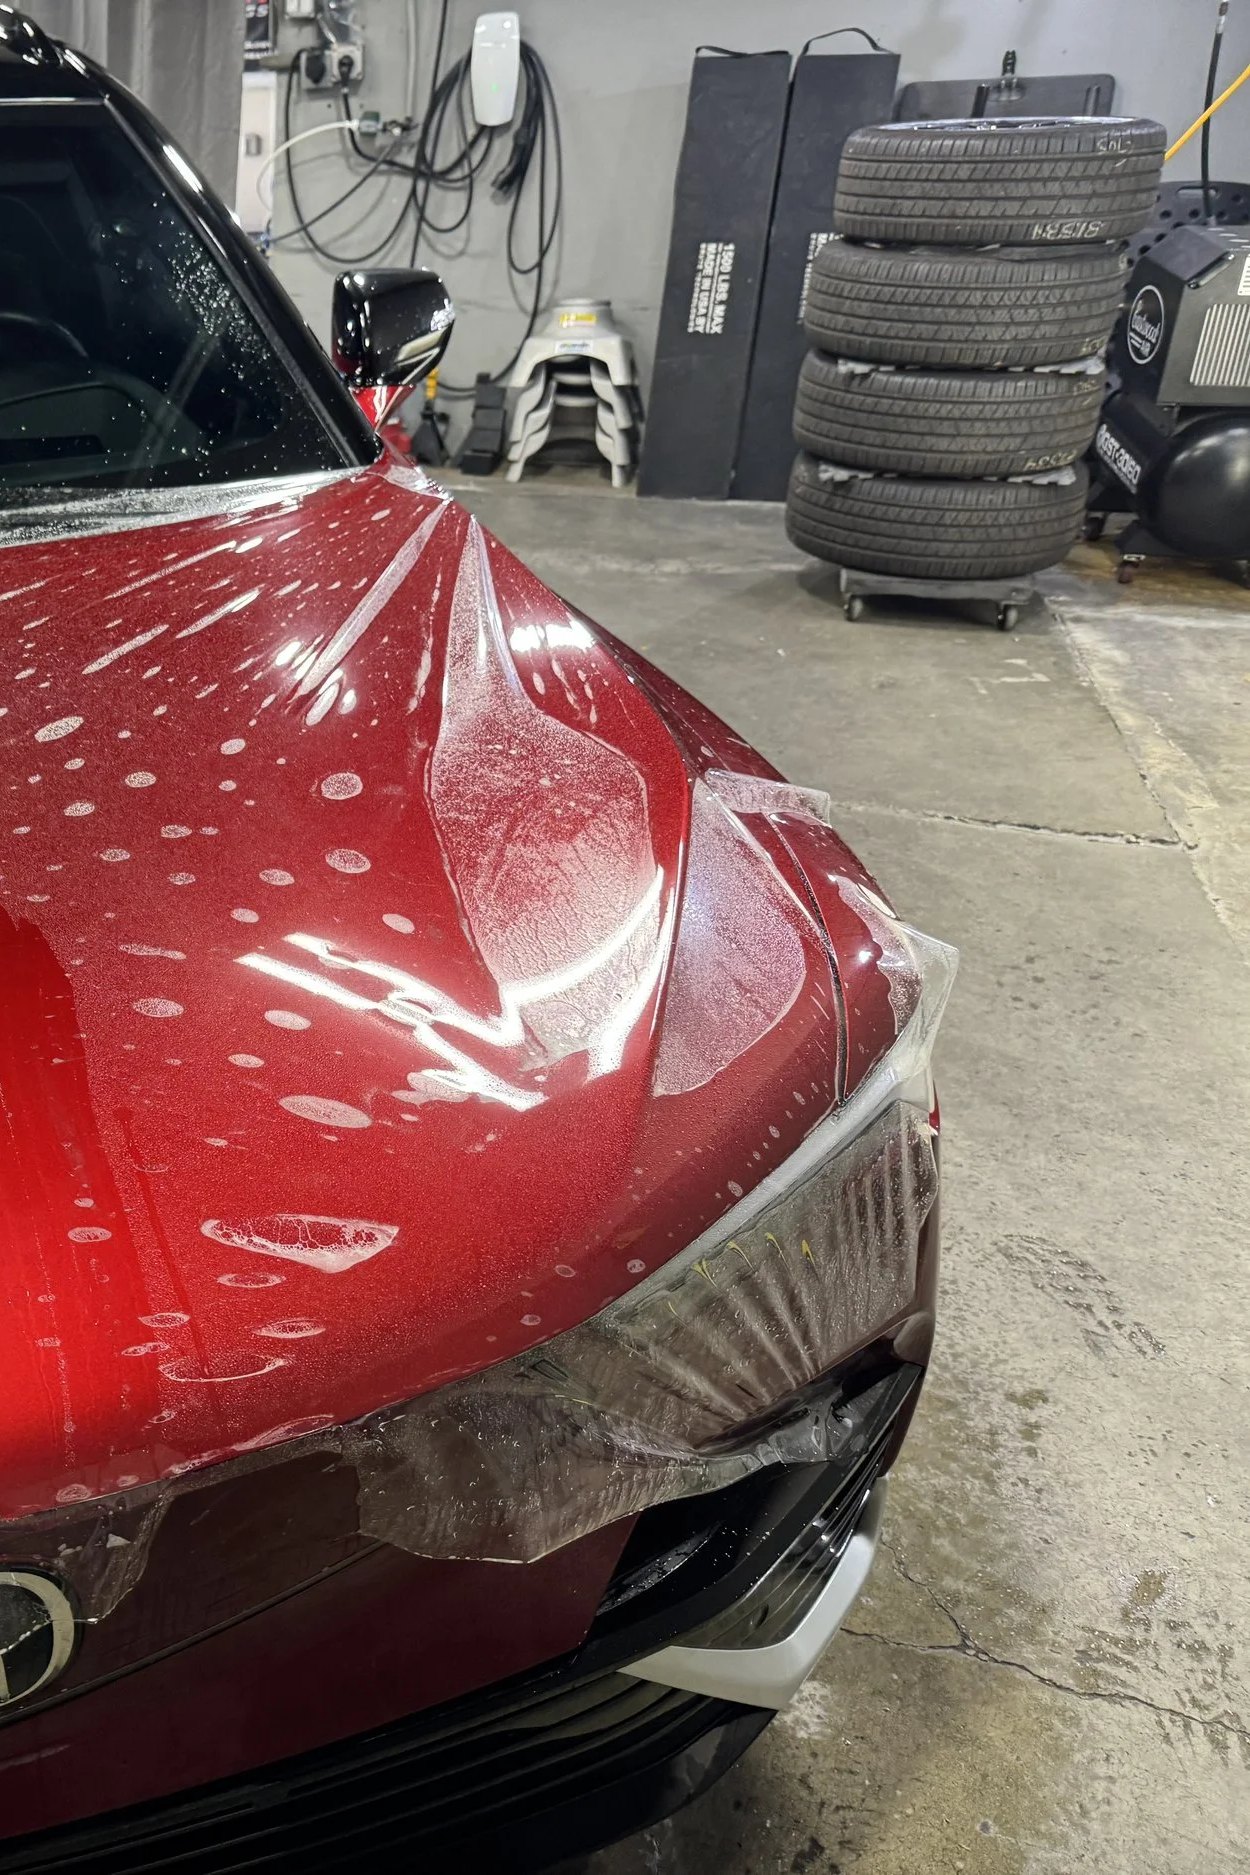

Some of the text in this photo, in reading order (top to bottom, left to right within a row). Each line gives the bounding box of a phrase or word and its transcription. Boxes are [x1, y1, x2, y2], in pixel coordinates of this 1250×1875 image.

[702, 243, 717, 276] MADE
[697, 291, 709, 315] USA
[711, 304, 726, 334] MAX
